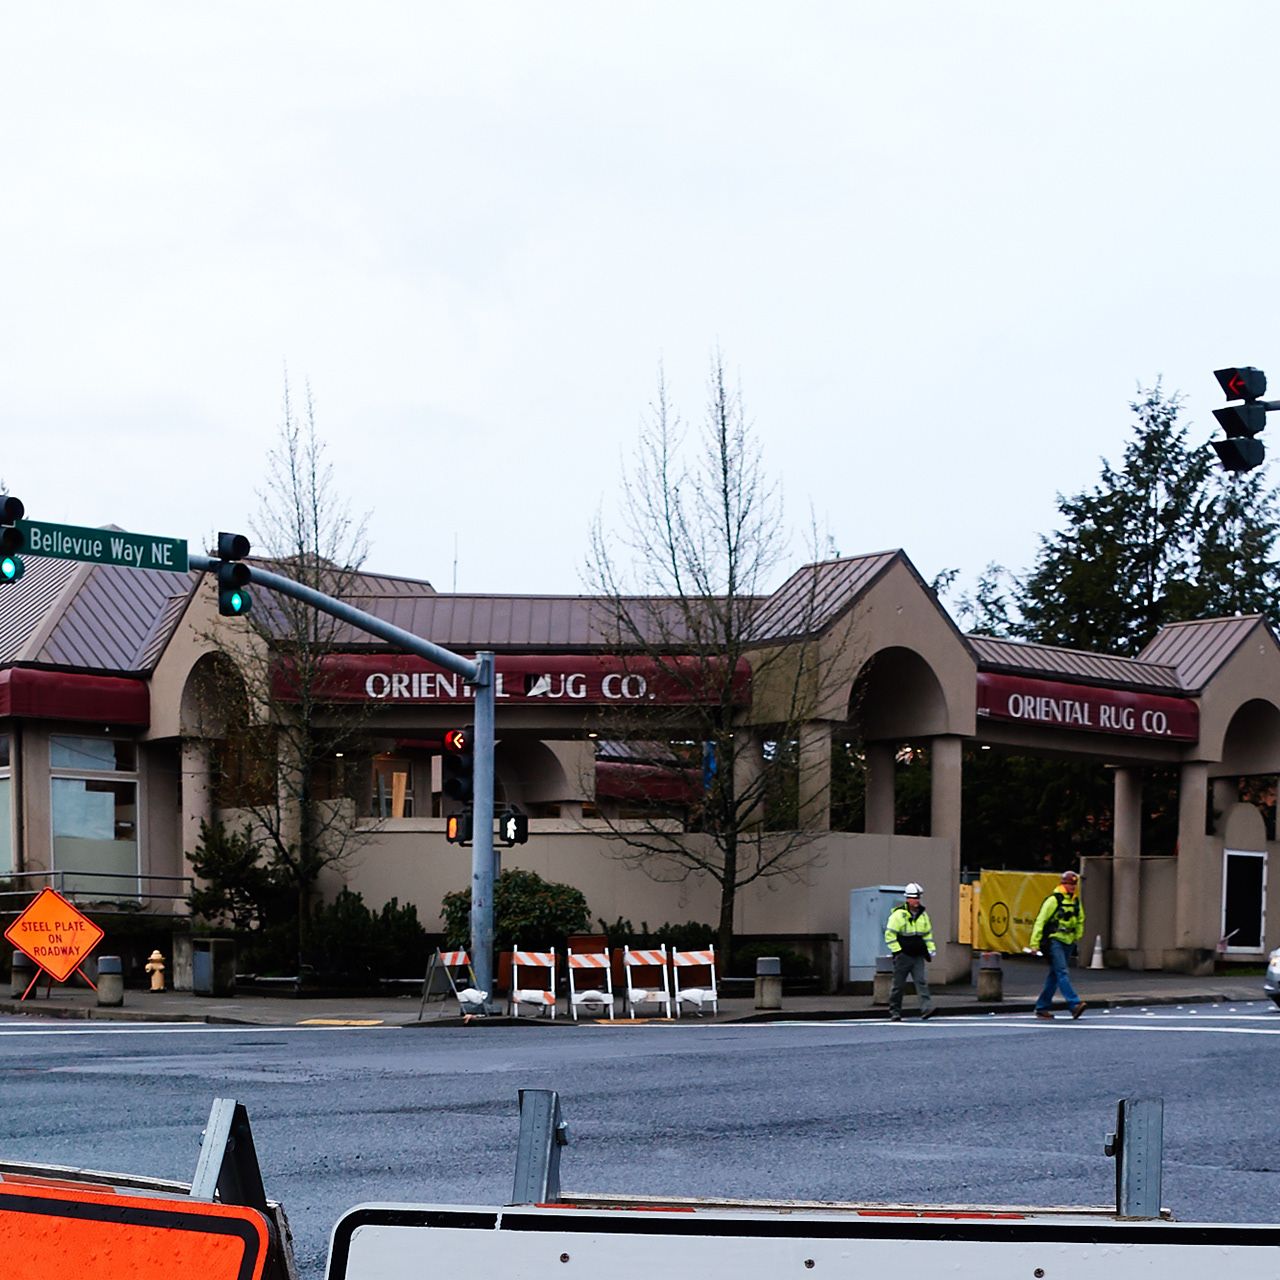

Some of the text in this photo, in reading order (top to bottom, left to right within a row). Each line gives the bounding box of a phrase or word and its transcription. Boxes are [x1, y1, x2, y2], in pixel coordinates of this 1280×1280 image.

[30, 528, 173, 567] Bellevue Way NE
[365, 673, 656, 699] ORIENTL UG CO.
[1008, 693, 1173, 735] ORIENTAL RUG CO.
[21, 921, 86, 932] STEEL PLATE
[48, 934, 62, 943] ON
[33, 946, 80, 956] ROADWAY
